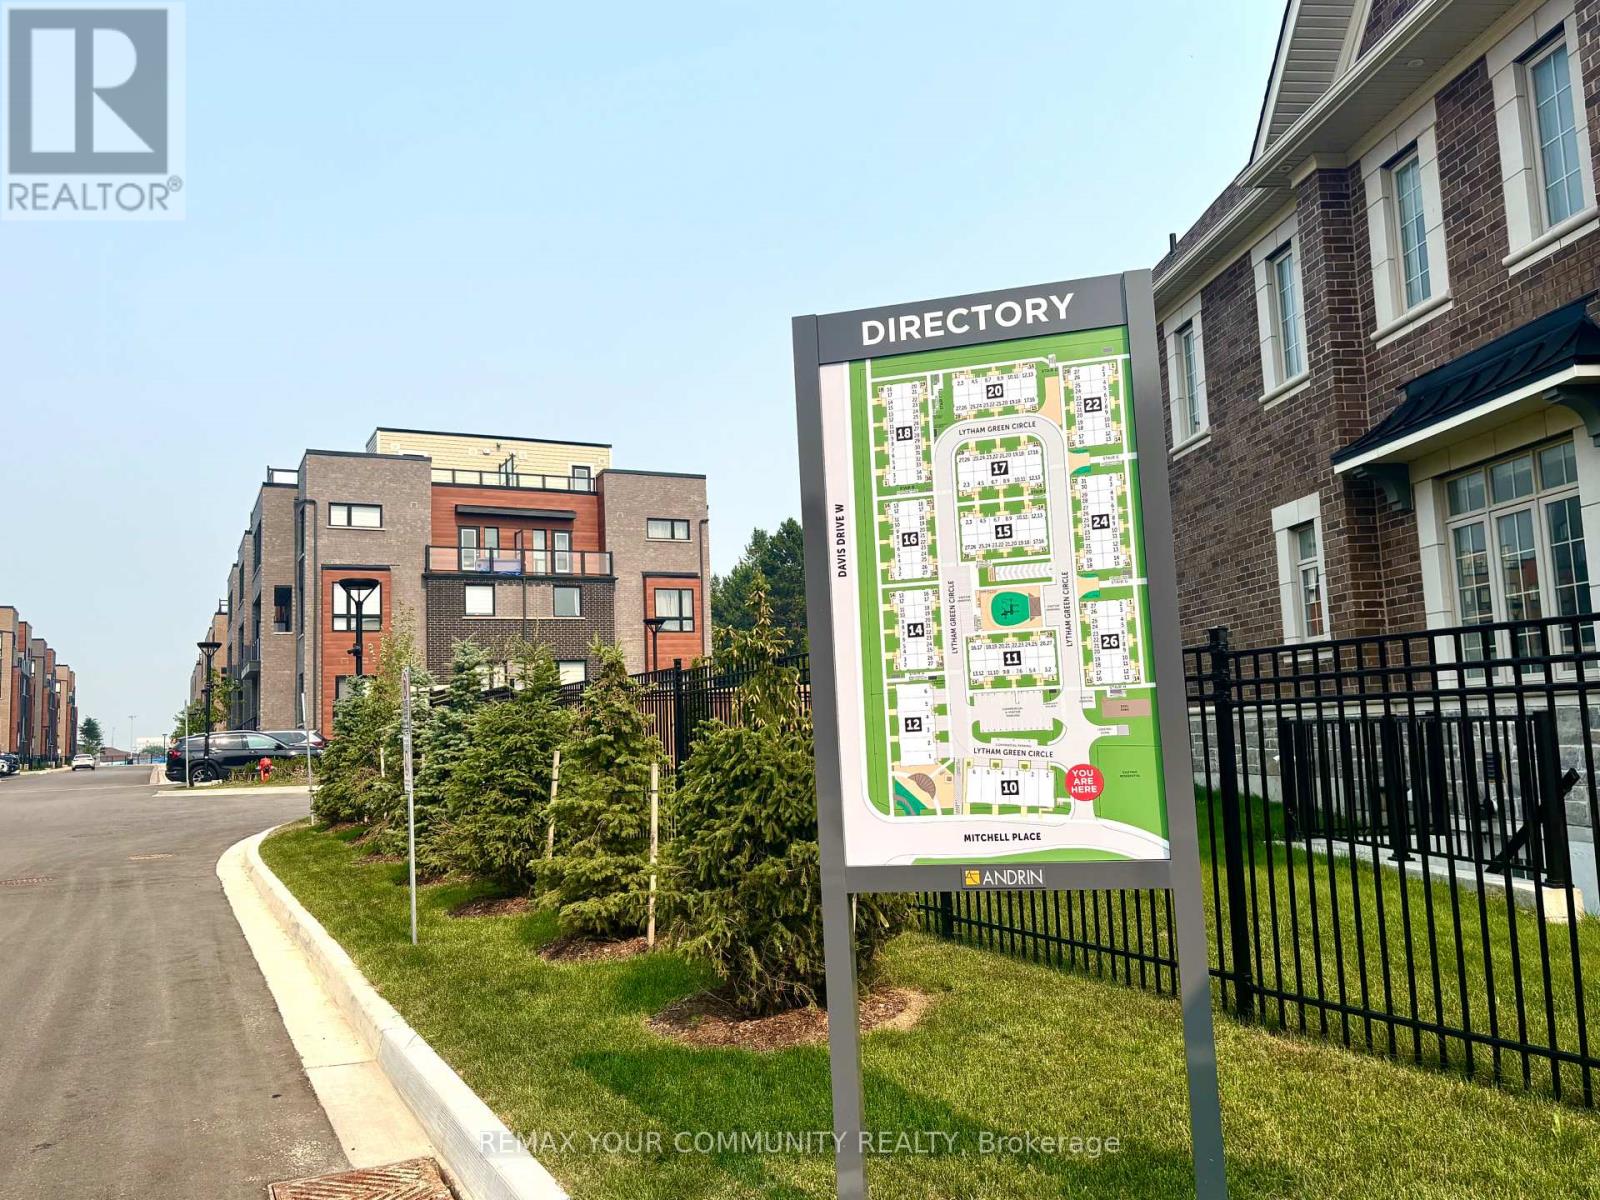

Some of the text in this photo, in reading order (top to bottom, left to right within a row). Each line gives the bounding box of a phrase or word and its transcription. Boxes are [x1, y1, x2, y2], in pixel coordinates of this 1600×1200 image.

[861, 292, 1074, 346] DIRECTORY
[987, 385, 1002, 398] 20
[1085, 399, 1101, 411] 22
[898, 428, 912, 439] 18
[959, 427, 985, 435] LYTHAM
[1012, 421, 1036, 429] CIRCLE
[992, 463, 1007, 475] 17
[1092, 515, 1108, 528] 24
[996, 525, 1011, 537] 15
[835, 504, 847, 577] DAVIS DRIVE W
[904, 534, 918, 545] 16
[909, 625, 923, 636] 14
[1102, 636, 1118, 648] 26
[1006, 653, 1020, 664] 11
[906, 719, 920, 730] 12
[1003, 782, 1017, 794] 10
[964, 832, 1041, 842] MITCHELL PLACE
[983, 869, 1043, 885] ANDRIN
